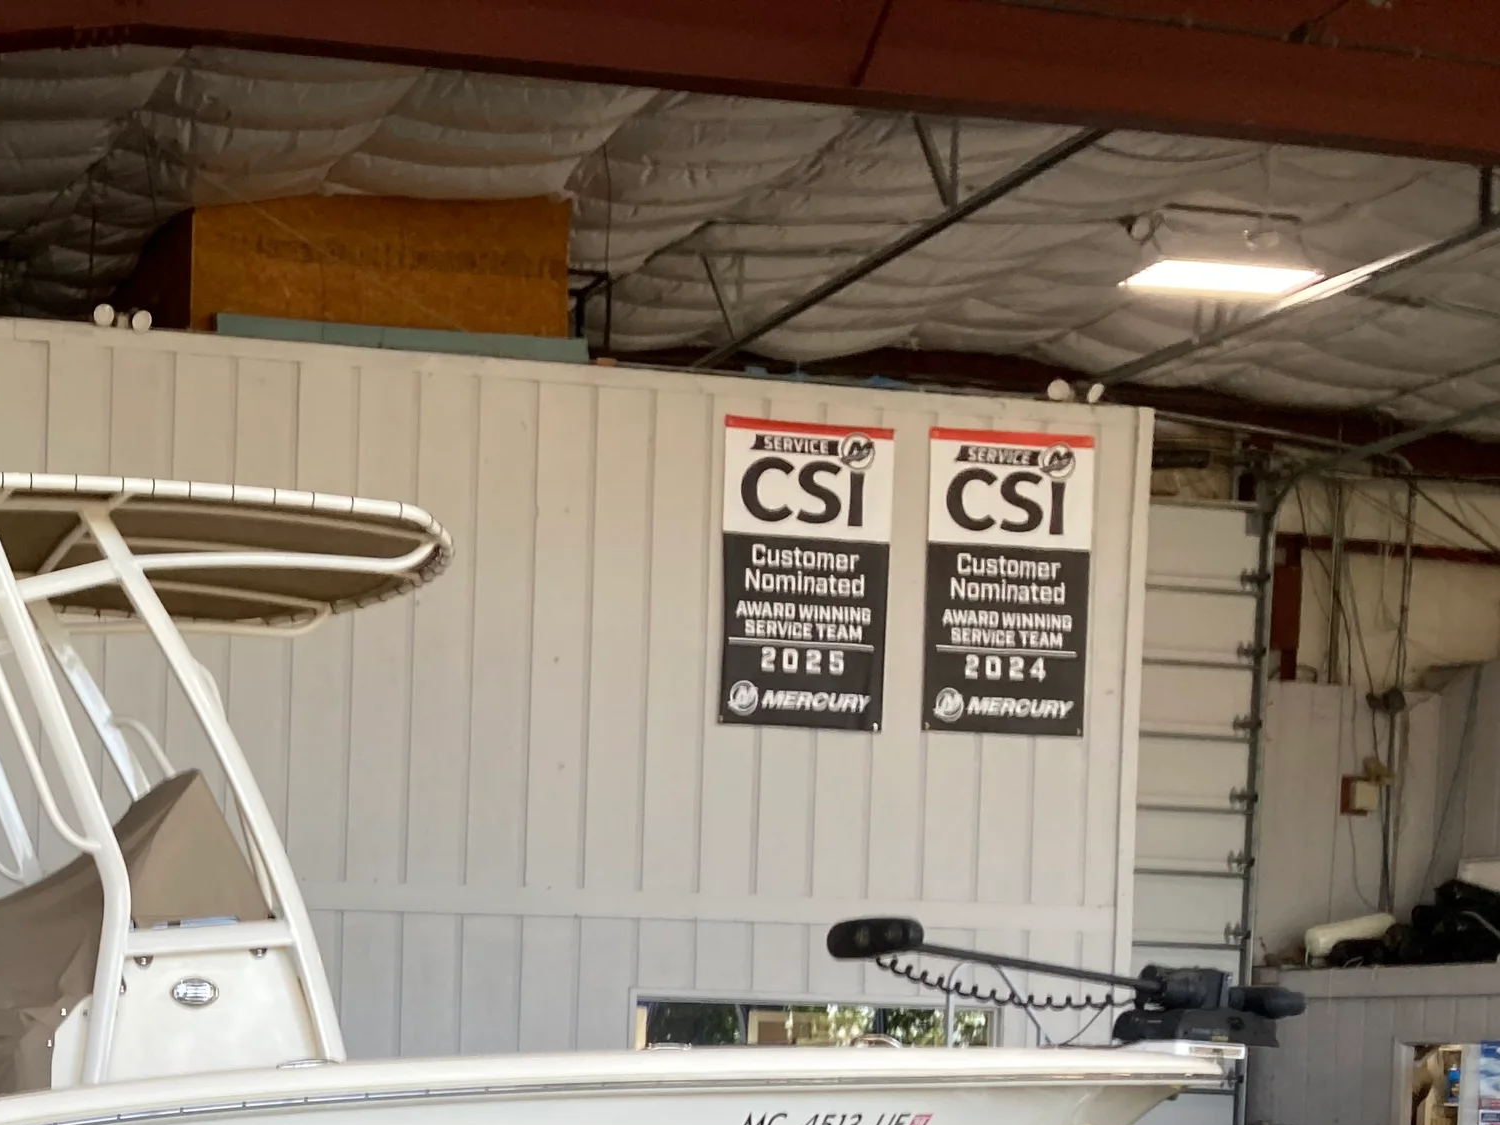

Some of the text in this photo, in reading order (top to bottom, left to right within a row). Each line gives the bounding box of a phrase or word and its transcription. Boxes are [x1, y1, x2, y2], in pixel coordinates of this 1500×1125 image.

[764, 435, 829, 454] SERVICE
[968, 446, 1030, 465] SERVICE
[752, 543, 860, 572] Customer
[957, 552, 1061, 580] Customer
[745, 568, 865, 598] Nominated
[950, 577, 1065, 605] Nominated
[736, 600, 872, 625] AWARD WINNING
[942, 608, 1073, 632] AWARD WINNING
[744, 619, 862, 643] SERVICE TEAM
[951, 627, 1063, 649] SERVICE TEAM
[761, 646, 844, 675] 2025
[965, 654, 1046, 682] 2024
[761, 690, 871, 713] MERCURY
[966, 696, 1075, 719] MERCURY
